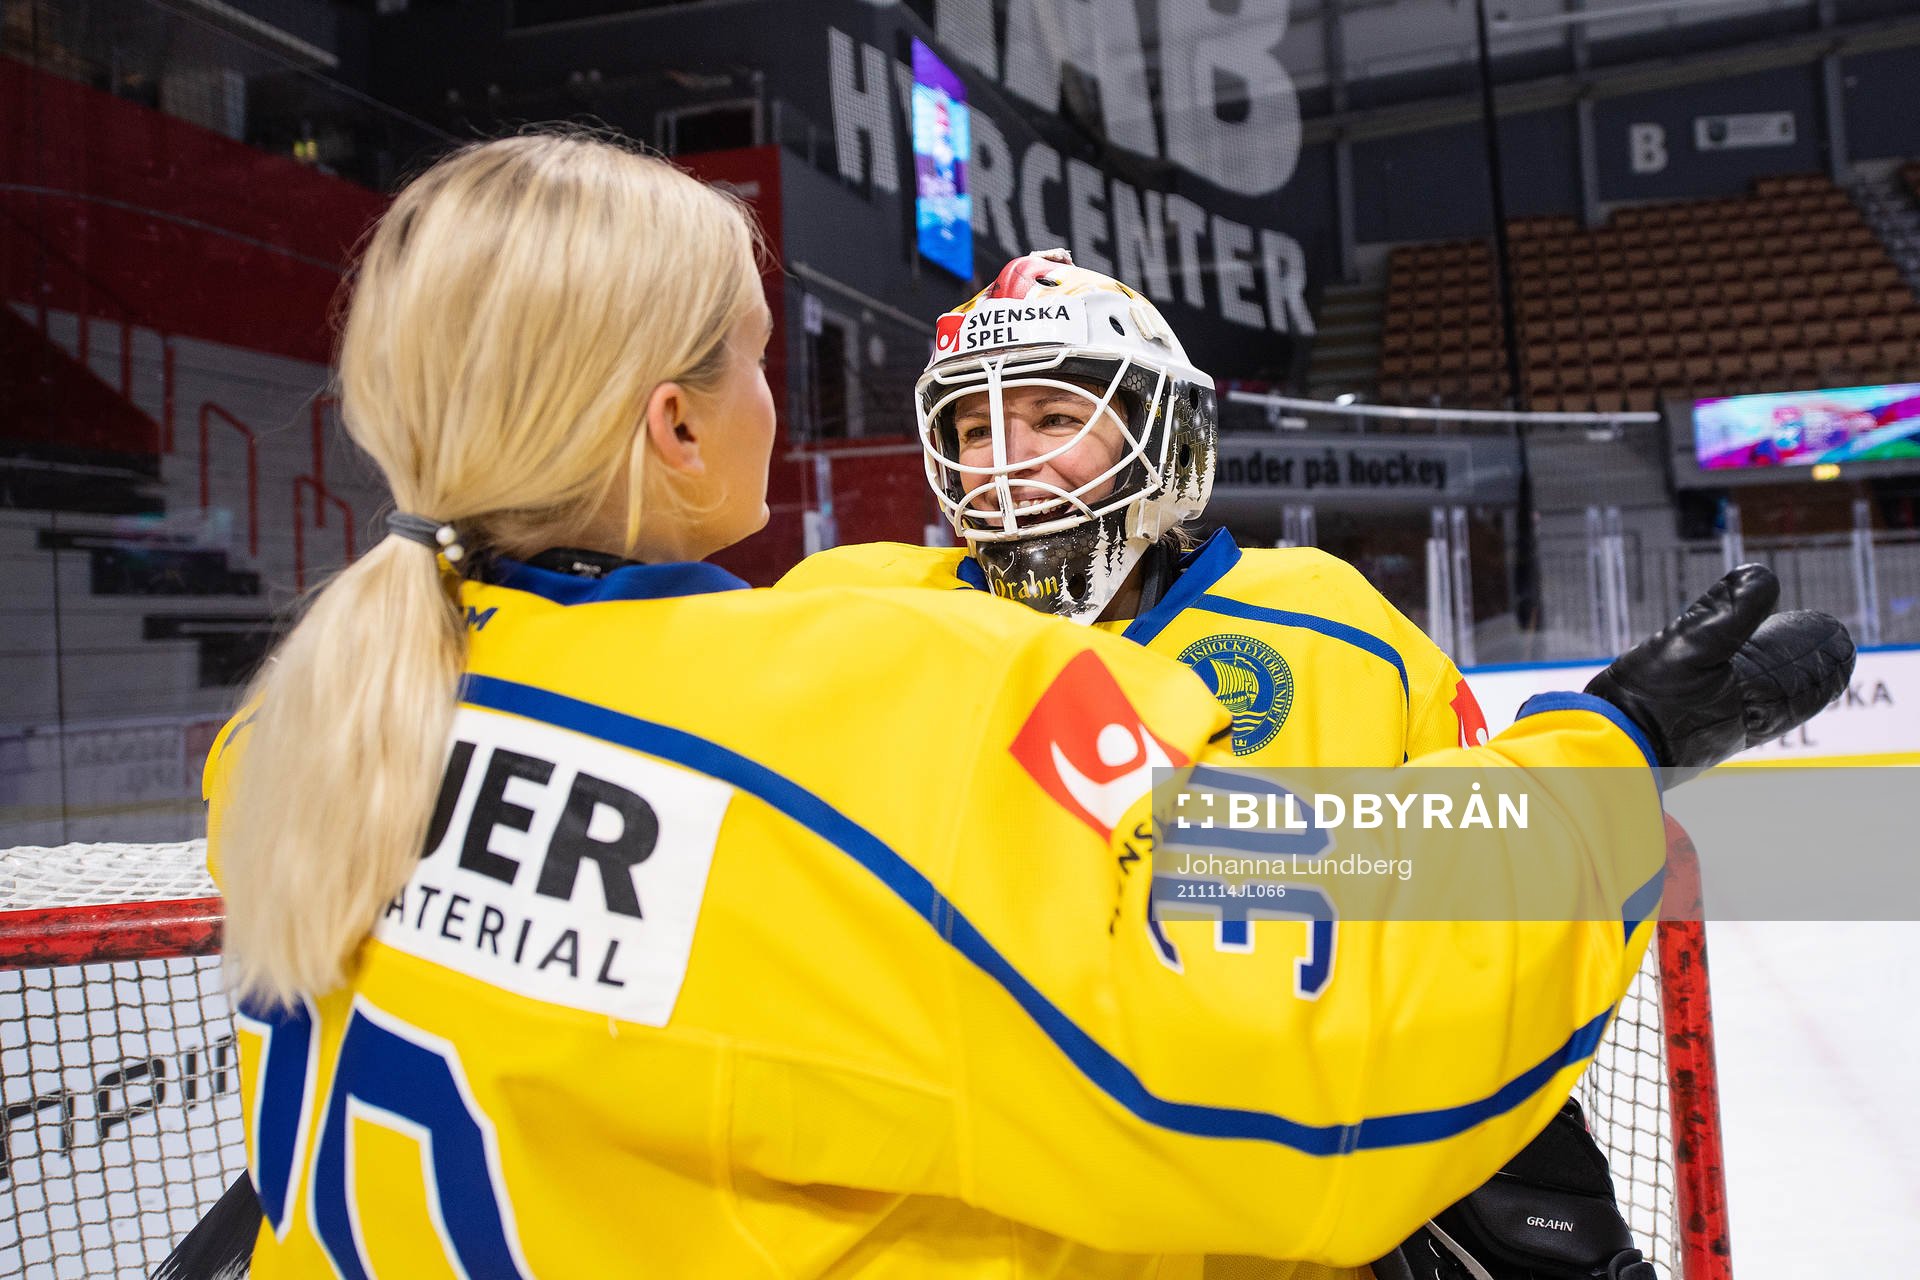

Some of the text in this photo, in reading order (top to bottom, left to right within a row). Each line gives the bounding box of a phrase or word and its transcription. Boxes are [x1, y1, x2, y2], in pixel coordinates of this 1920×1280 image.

[862, 0, 1302, 196] AB
[1630, 123, 1668, 173] B
[828, 27, 1316, 336] HRCENTER
[967, 304, 1070, 330] SVENSKA
[966, 327, 1019, 350] SPEL
[1304, 449, 1341, 489] på
[1348, 450, 1447, 490] hockey
[1526, 1216, 1574, 1232] GRAHN
